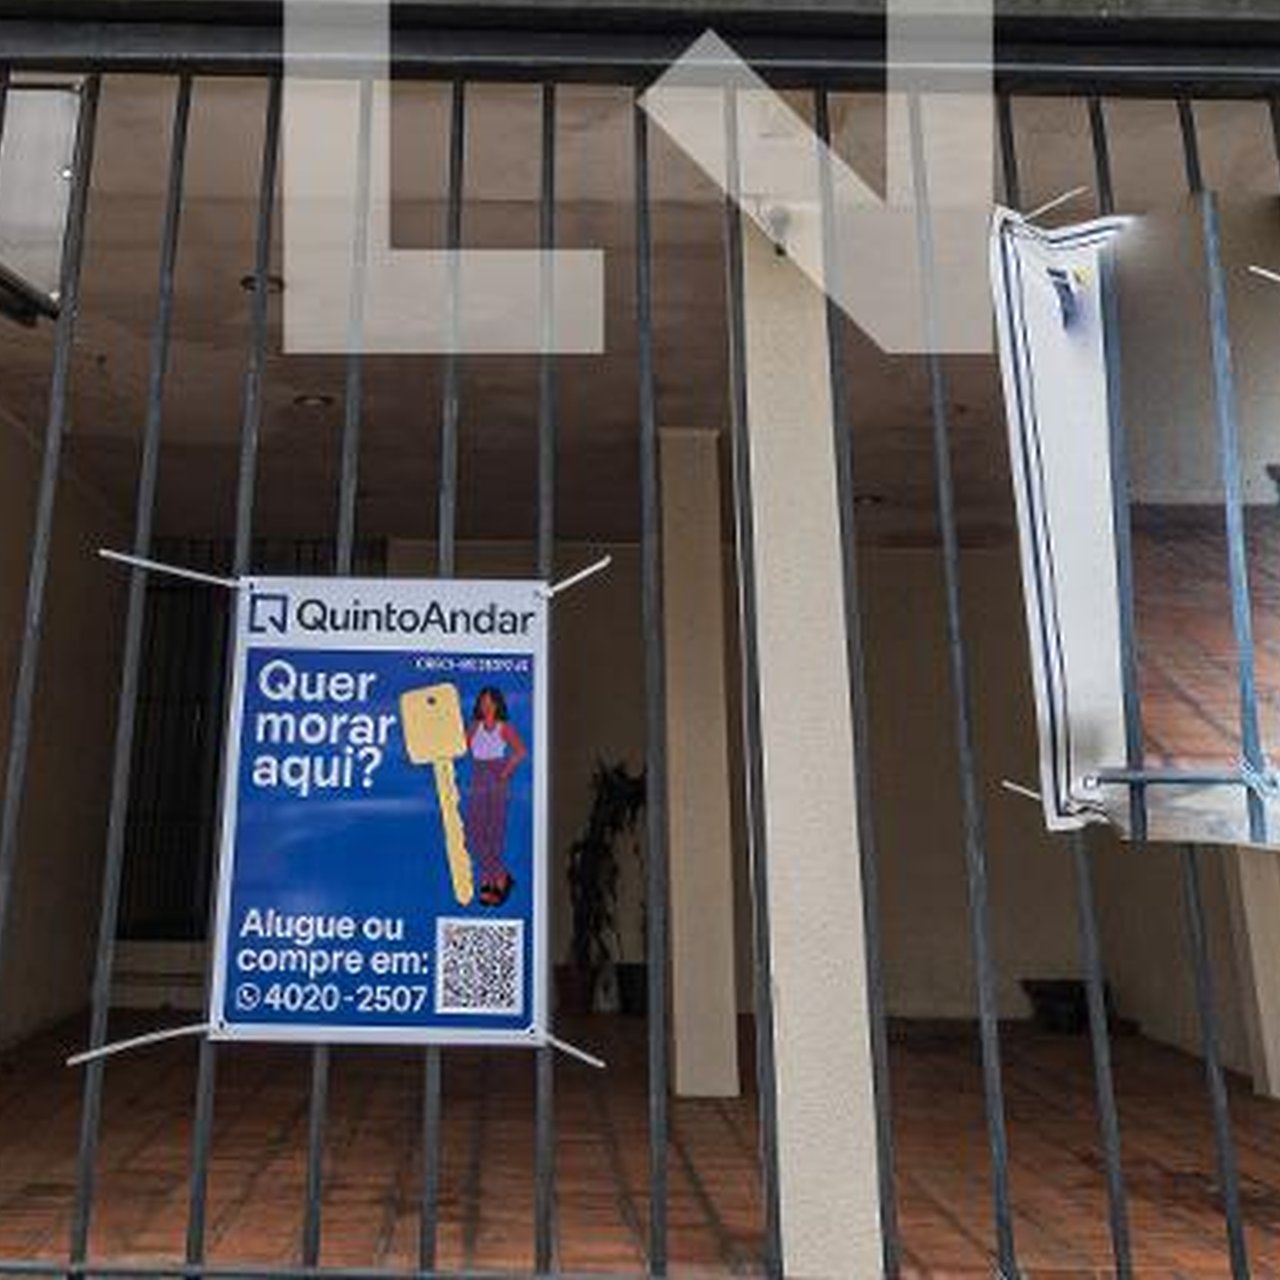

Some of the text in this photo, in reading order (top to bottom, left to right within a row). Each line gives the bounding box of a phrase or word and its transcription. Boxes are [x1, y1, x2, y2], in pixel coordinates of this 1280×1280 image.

[296, 599, 535, 635] QuintoAndar
[258, 659, 376, 701] Quer
[255, 711, 397, 744] morar
[252, 746, 383, 796] aqui?
[239, 908, 404, 946] Alugue ou
[236, 948, 430, 979] compre em:
